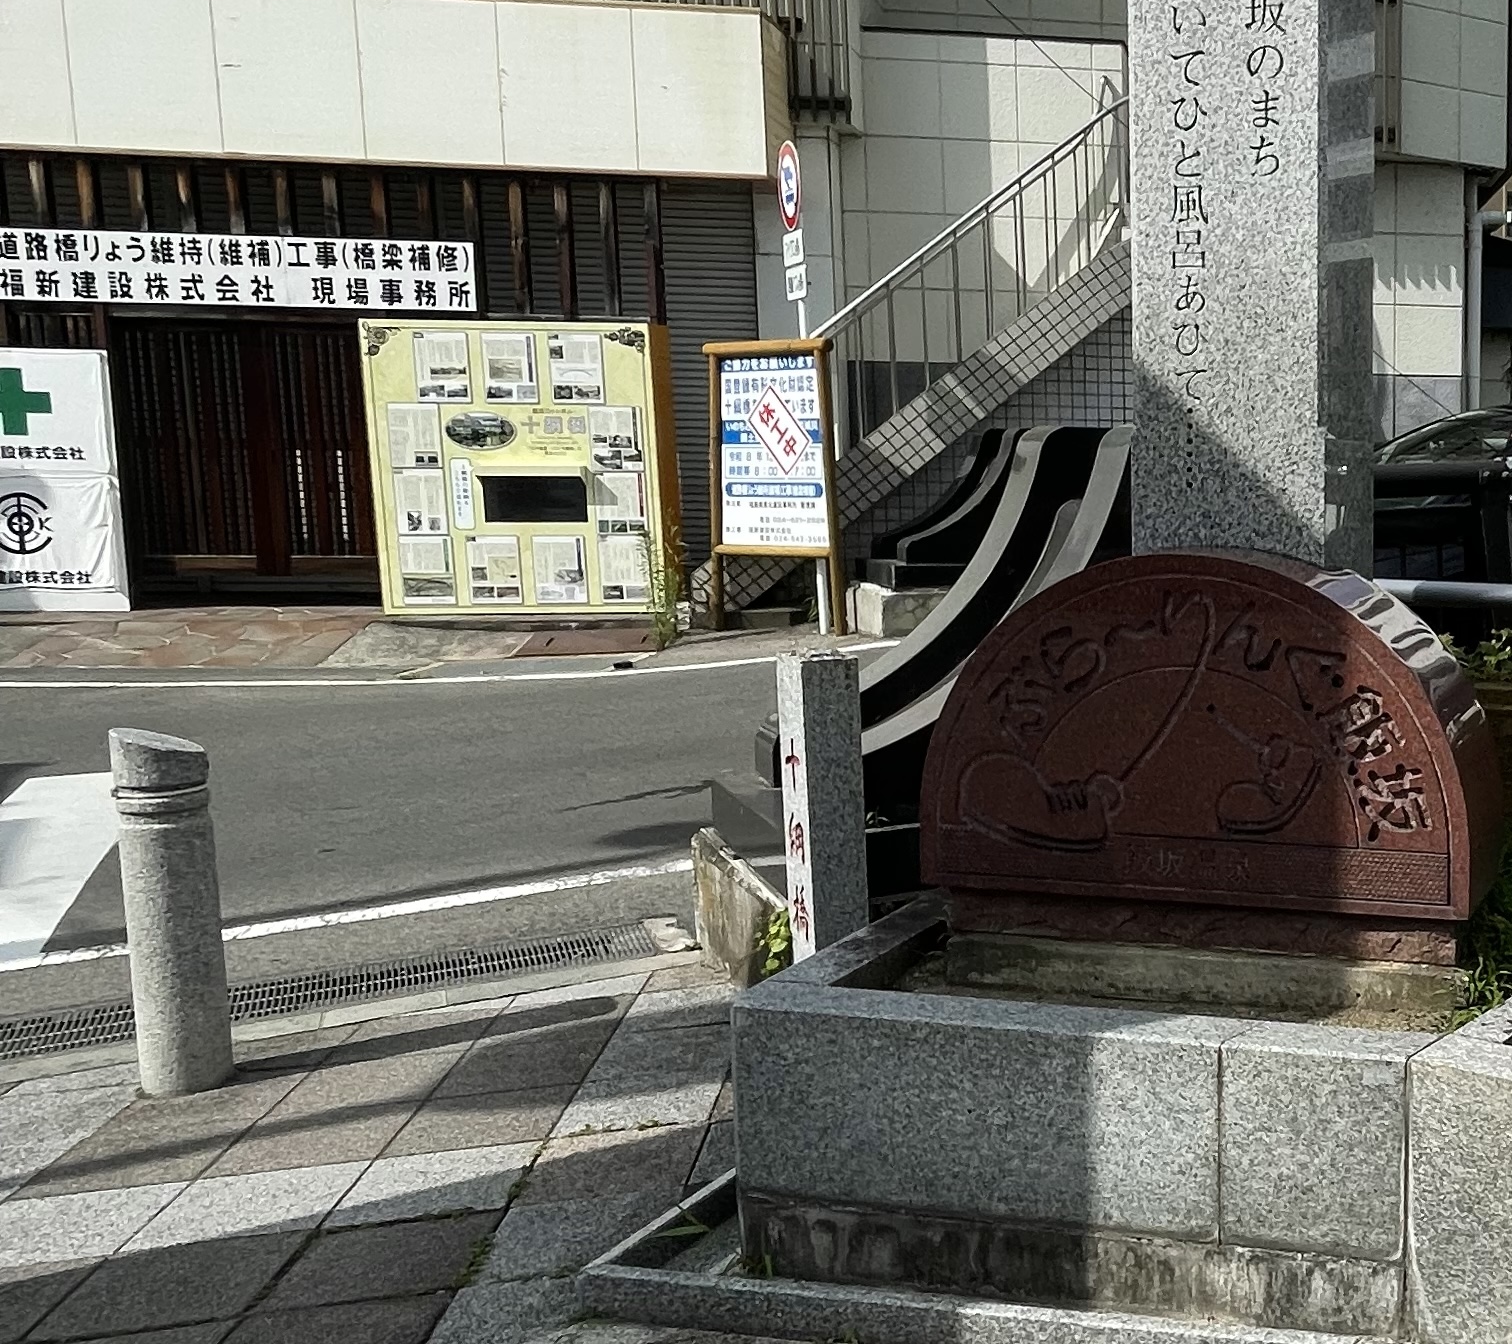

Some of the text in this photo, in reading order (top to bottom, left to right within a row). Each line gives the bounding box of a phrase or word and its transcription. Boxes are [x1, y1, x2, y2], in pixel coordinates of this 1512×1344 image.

[0, 268, 472, 309] 福新建設株式会社 現場事務所
[758, 402, 798, 456] 休工中
